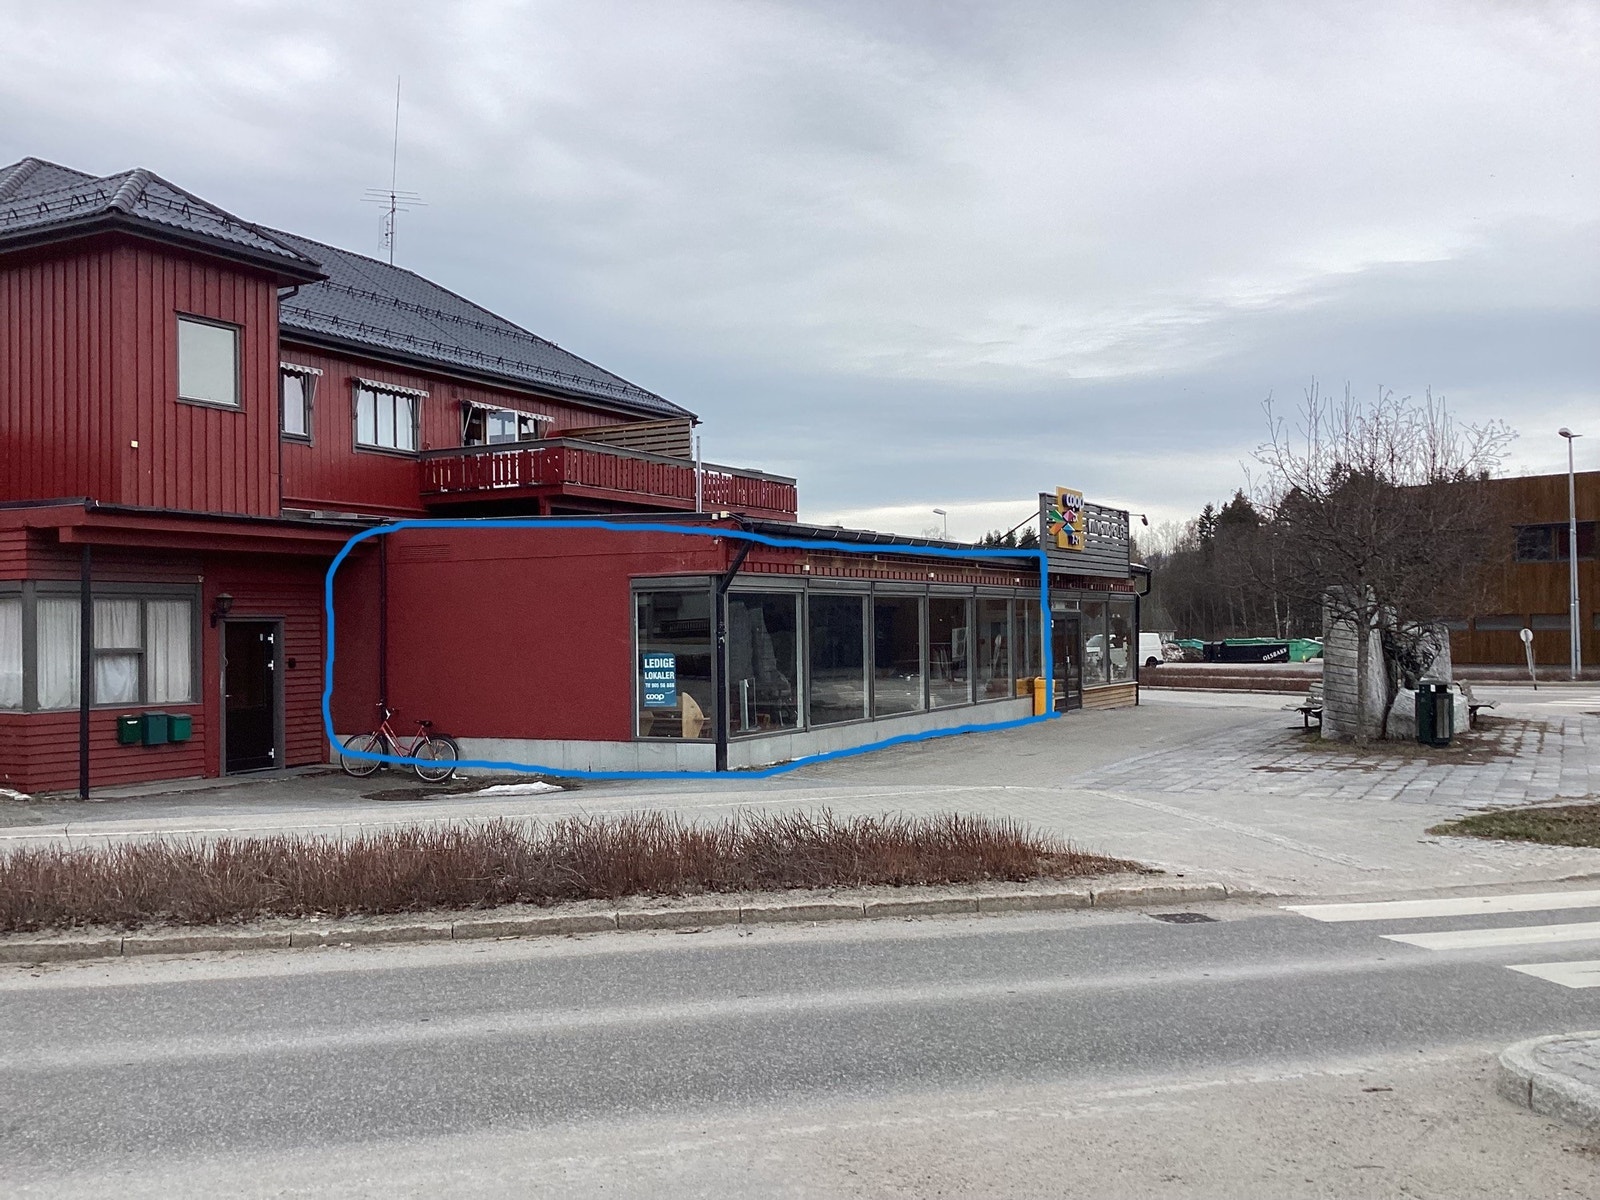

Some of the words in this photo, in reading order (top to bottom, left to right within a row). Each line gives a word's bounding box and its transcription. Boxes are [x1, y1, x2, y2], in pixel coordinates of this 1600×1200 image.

[1066, 493, 1084, 511] coop
[644, 658, 674, 668] LEDIGE
[644, 671, 675, 680] LOKALER
[646, 693, 665, 701] coop
